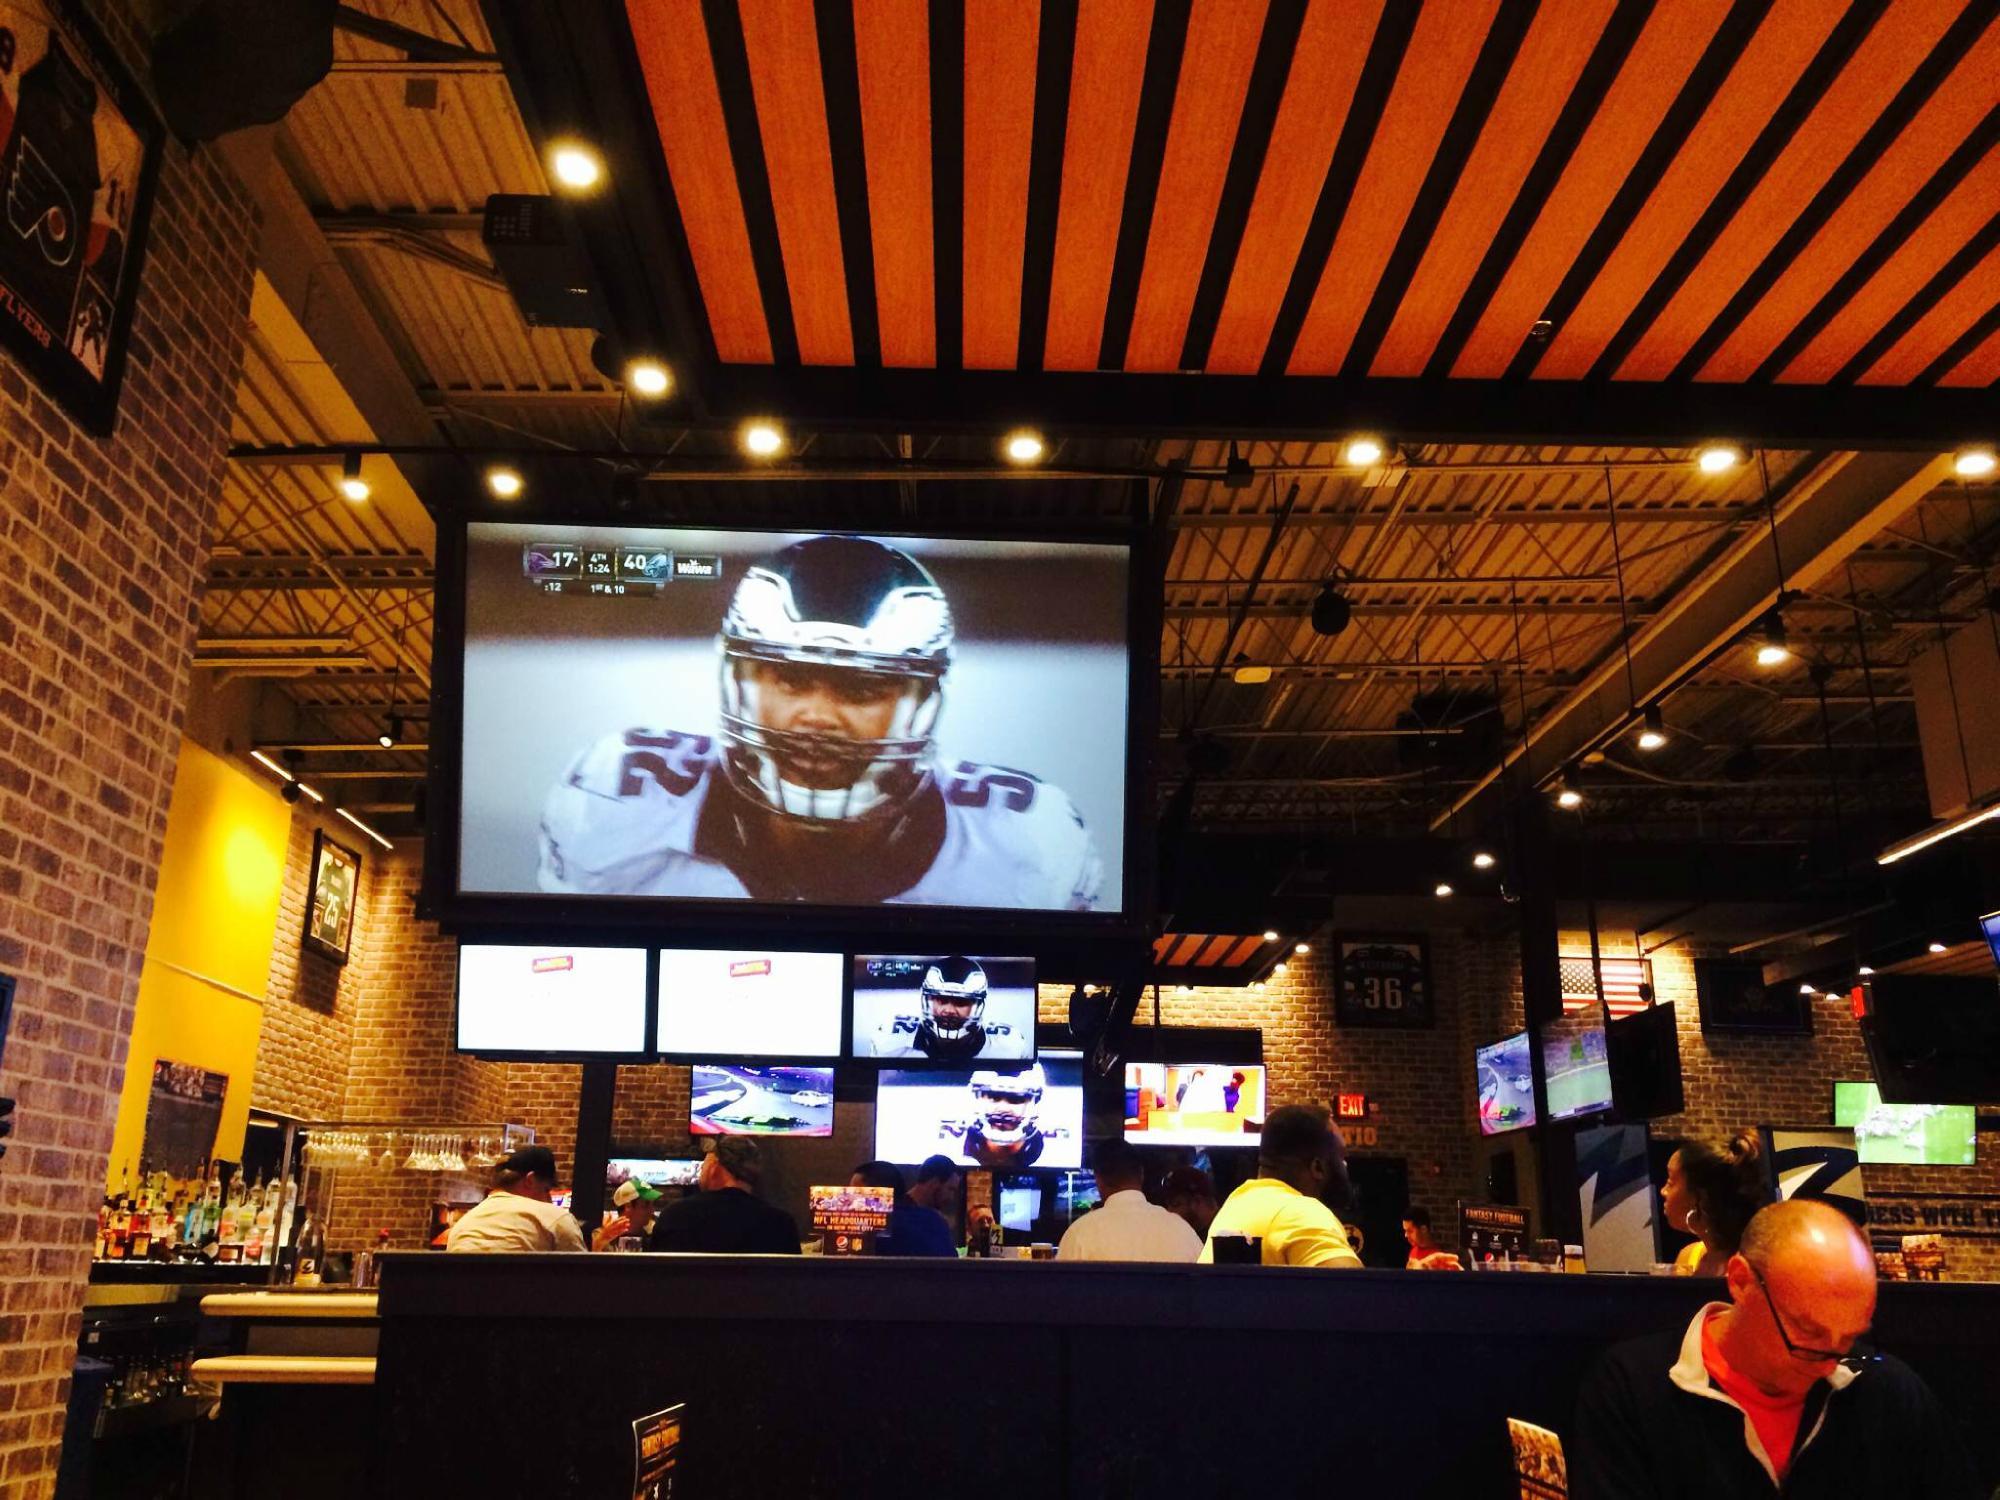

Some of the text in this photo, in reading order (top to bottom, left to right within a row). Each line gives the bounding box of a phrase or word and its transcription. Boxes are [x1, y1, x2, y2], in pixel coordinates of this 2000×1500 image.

[0, 283, 51, 349] FLYERS
[552, 552, 647, 570] 17 40
[588, 563, 611, 574] 1:24
[677, 560, 713, 575] Wawa
[604, 585, 613, 594] &
[614, 585, 625, 595] 10
[324, 892, 340, 928] 25
[1363, 976, 1403, 1010] 36
[1339, 1094, 1365, 1116] EXIT
[1340, 1126, 1378, 1146] TIO
[813, 1216, 887, 1226] NFL HEADQUARTERS
[1466, 1209, 1524, 1225] FANTASY FOOTBALL
